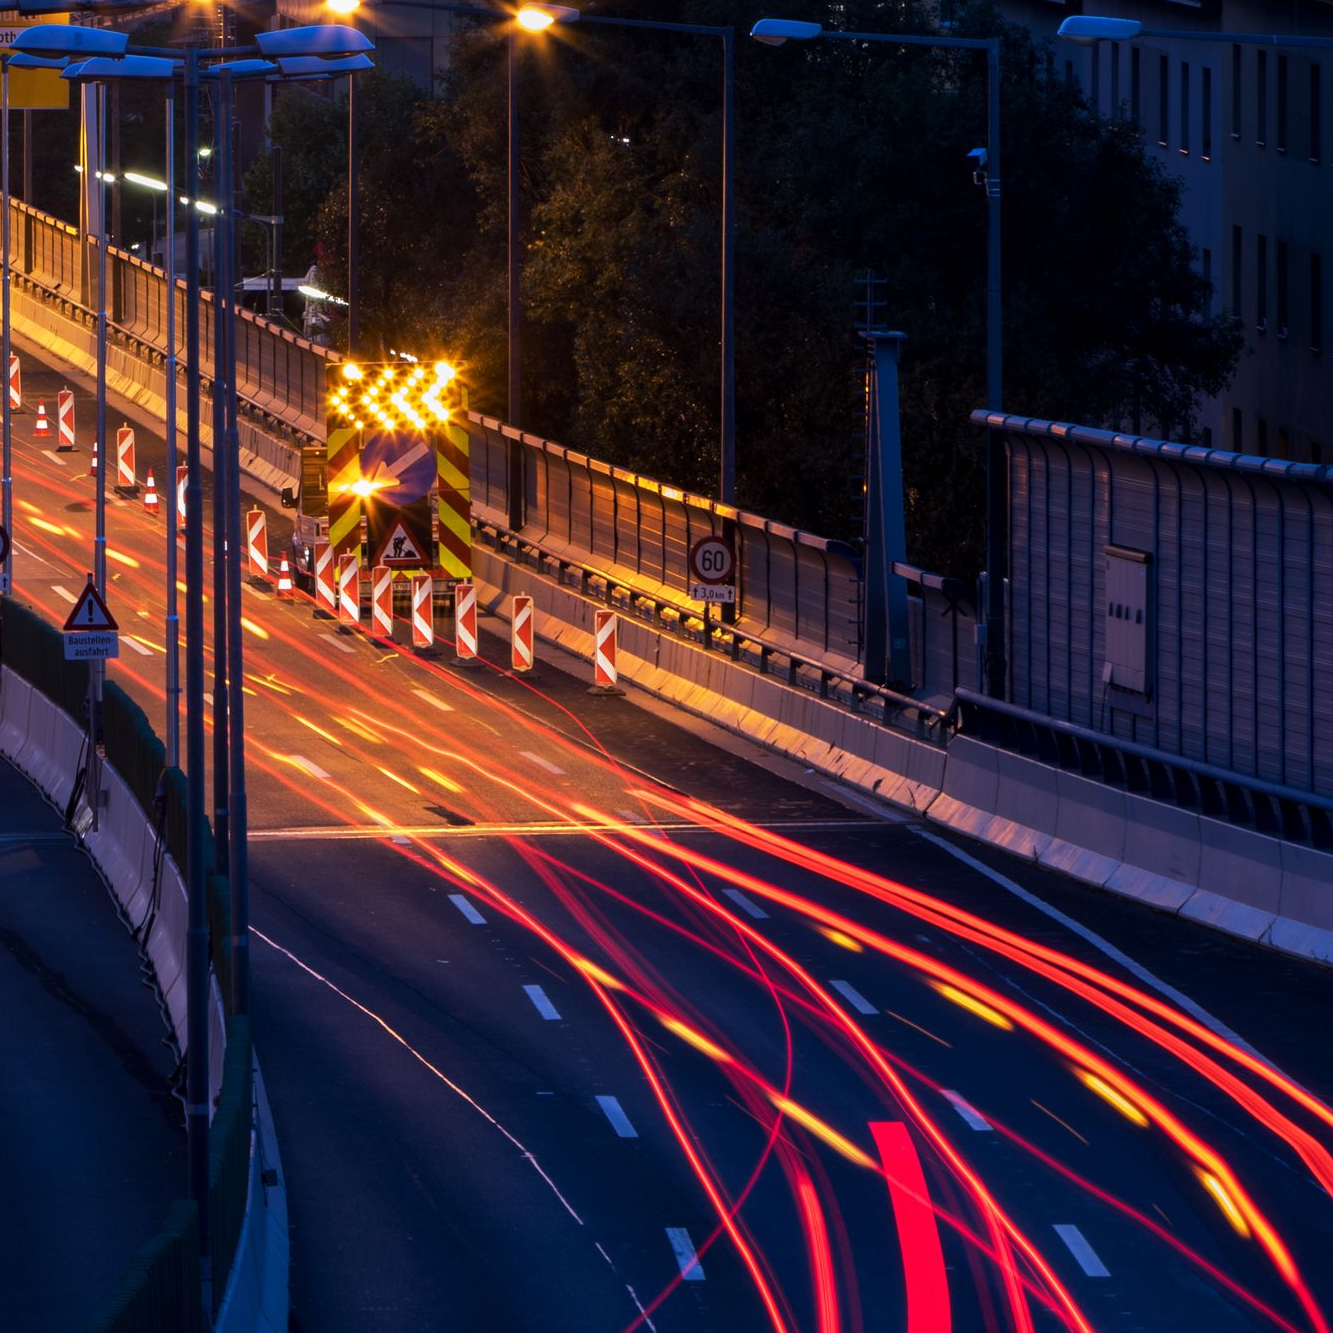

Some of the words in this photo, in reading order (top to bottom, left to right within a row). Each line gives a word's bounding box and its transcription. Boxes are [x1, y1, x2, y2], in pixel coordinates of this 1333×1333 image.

[702, 549, 724, 572] 60
[701, 587, 714, 600] 3,0
[715, 590, 725, 599] km
[68, 636, 115, 645] Baustellen-
[74, 647, 109, 657] ausfahrt
